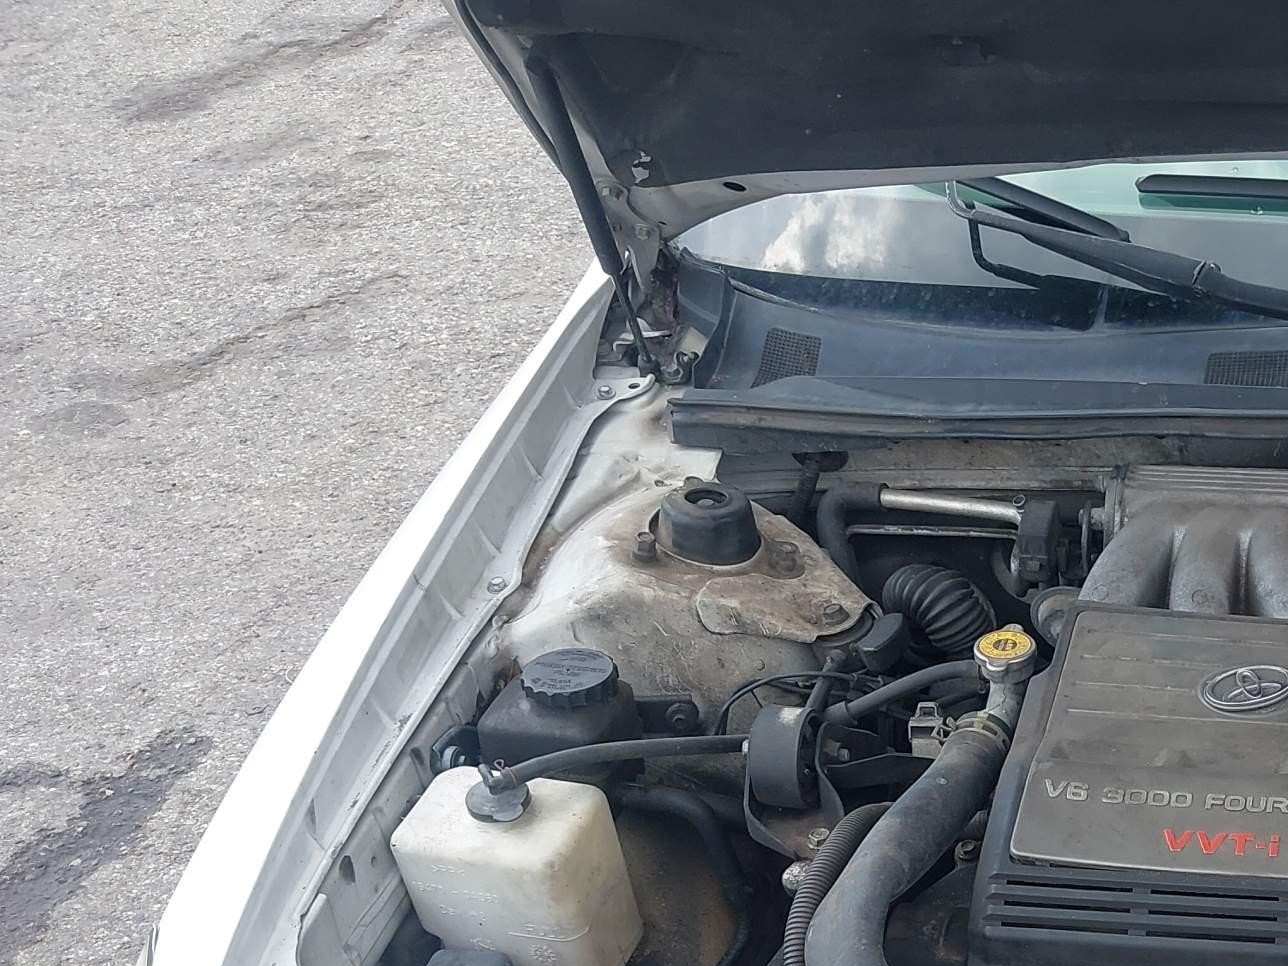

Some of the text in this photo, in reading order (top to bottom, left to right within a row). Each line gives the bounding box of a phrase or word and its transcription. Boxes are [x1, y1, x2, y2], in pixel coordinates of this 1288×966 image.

[1045, 778, 1089, 801] V6
[1101, 786, 1193, 807] 3000
[1205, 793, 1288, 814] FOUR
[1163, 828, 1281, 857] VVT-i
